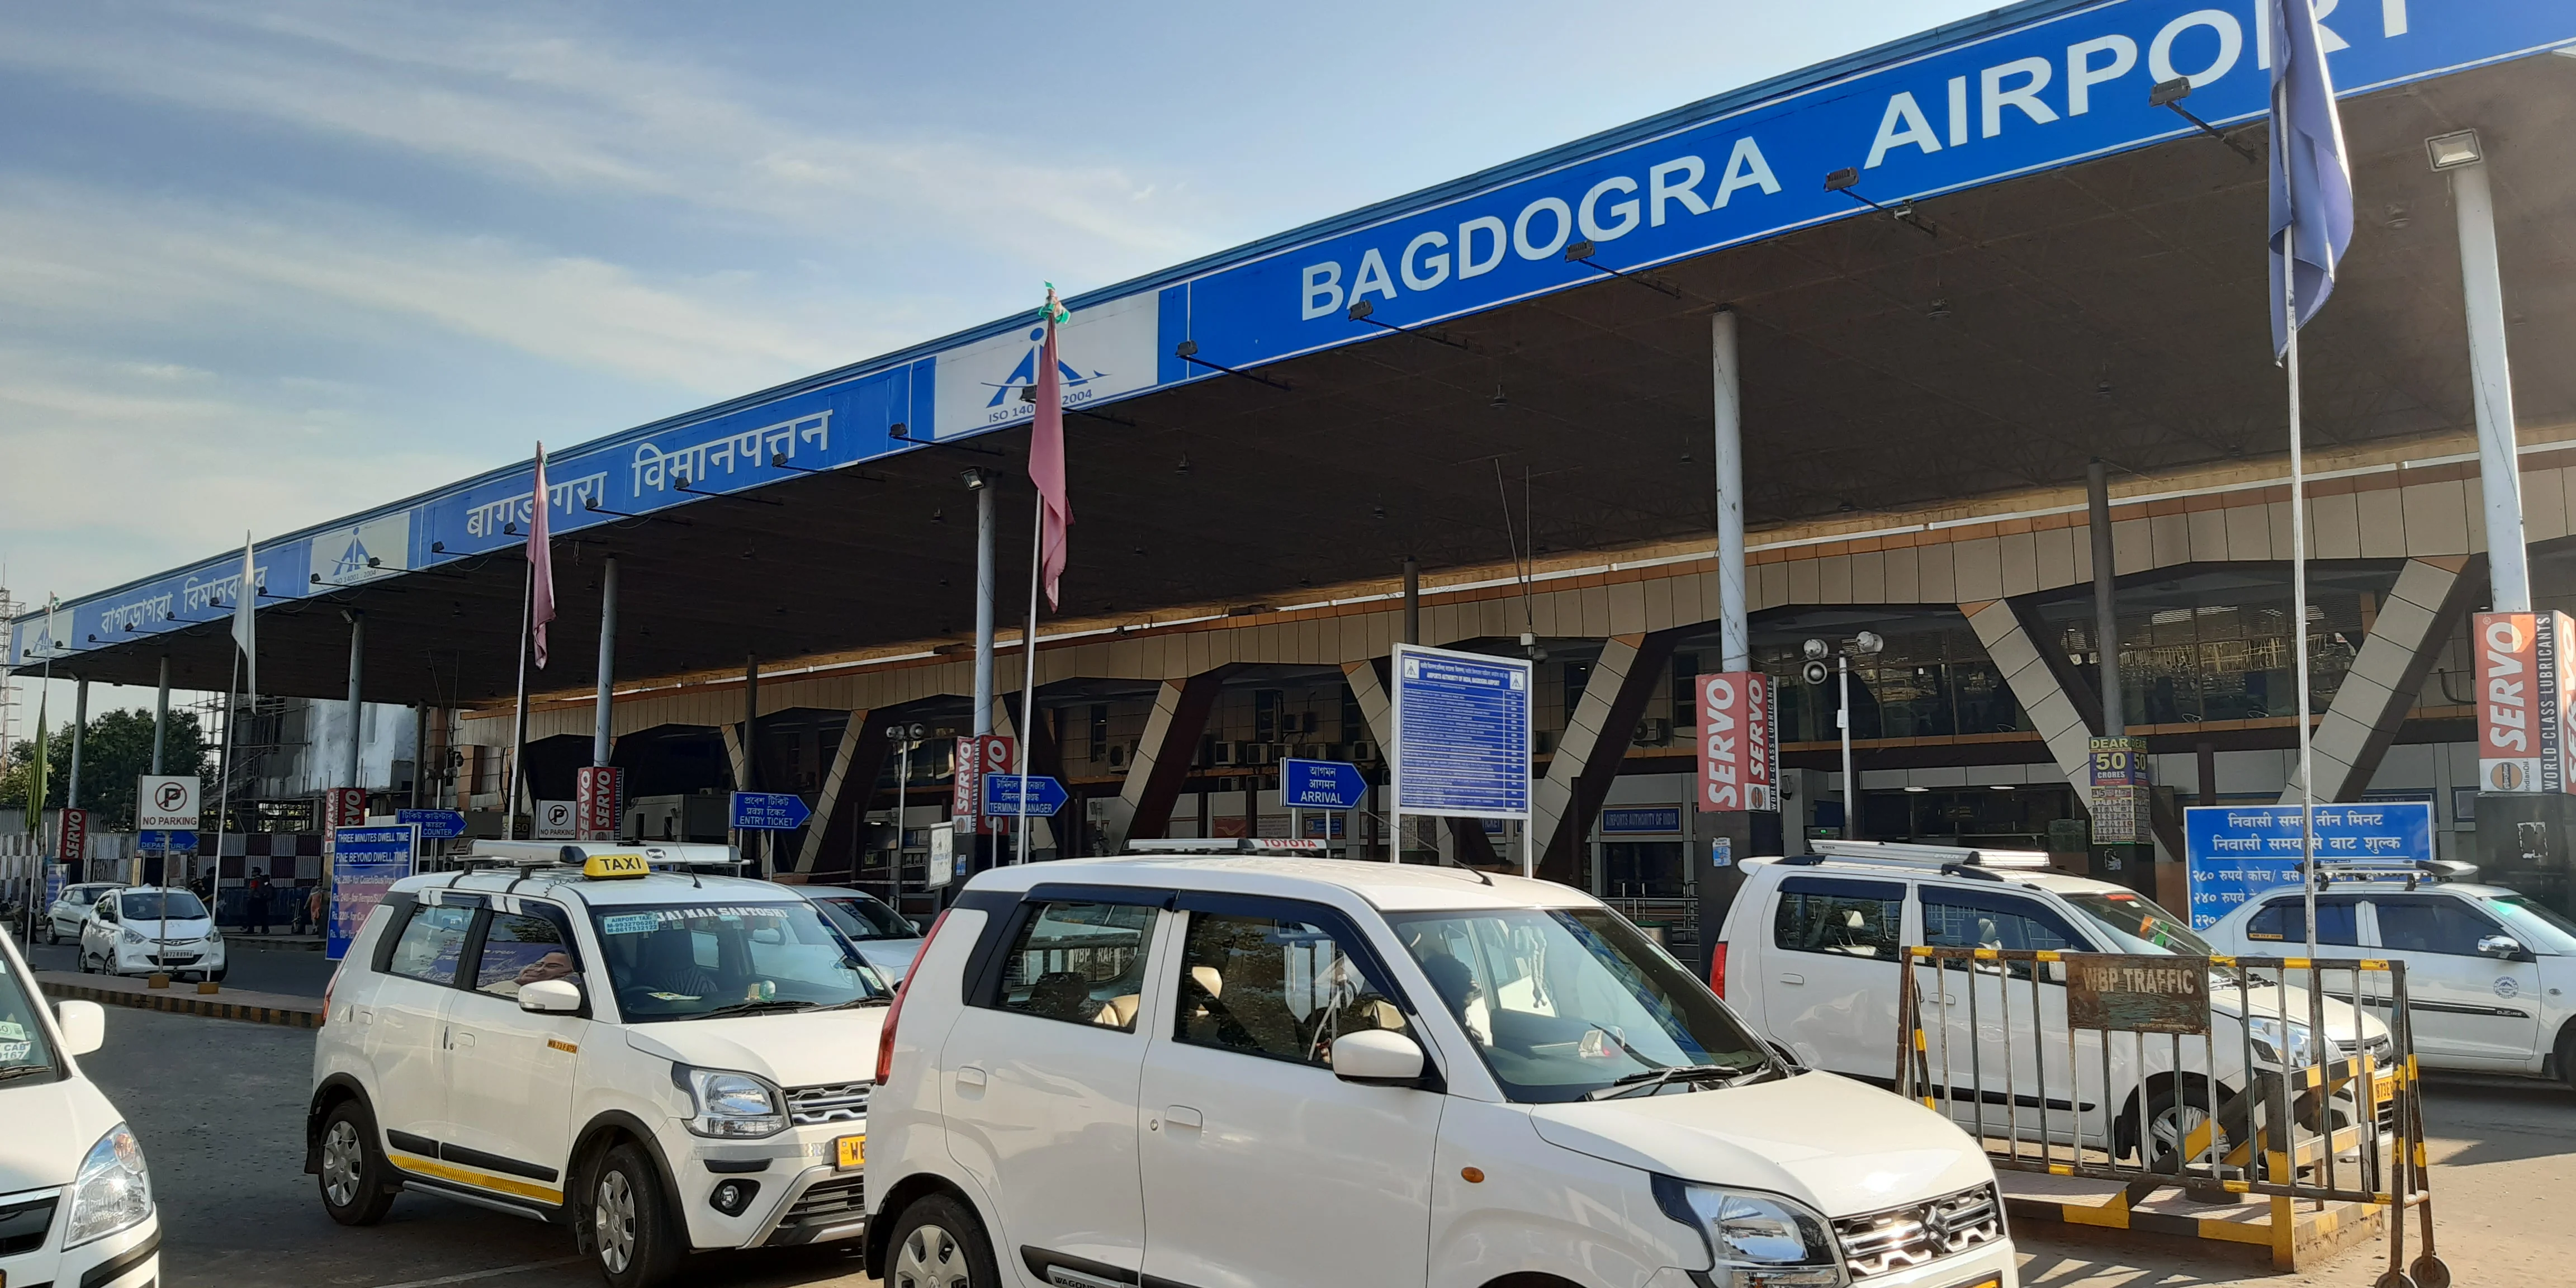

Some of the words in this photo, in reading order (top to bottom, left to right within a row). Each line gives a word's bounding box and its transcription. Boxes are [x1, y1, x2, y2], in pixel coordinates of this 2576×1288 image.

[1301, 136, 1782, 321] BAGDOGRA
[989, 410, 1008, 423] ISO
[1013, 404, 1035, 417] 140
[1063, 389, 1092, 405] 2004
[632, 409, 833, 497] विमानपत्तन
[2537, 617, 2554, 694] LUBRICANTS
[2486, 622, 2527, 752] SERVO
[1748, 679, 1765, 780] SERVO
[1706, 679, 1737, 808] SERVO
[2091, 738, 2128, 749] DEAR
[2541, 699, 2559, 790] WORLD-CLASS
[2096, 752, 2126, 770] 50
[2134, 754, 2146, 770] 50
[957, 742, 971, 812] SERVO
[1309, 766, 1336, 777] আগমন
[1309, 779, 1336, 790] आगमन
[580, 770, 591, 841] SERVO
[596, 770, 611, 828] SERVO
[1300, 790, 1343, 804] ARRIVAL
[326, 792, 335, 838] SERVO
[344, 790, 361, 826] RVO
[989, 803, 1020, 812] TERMINAL
[1025, 803, 1052, 813] ANAGER
[143, 817, 156, 825] NO
[158, 817, 197, 825] PARKING
[740, 816, 765, 825] ENTRY
[767, 817, 793, 826] TICKET
[2228, 812, 2272, 828] निवासी
[2315, 811, 2342, 826] तीन
[2348, 811, 2383, 826] मिनट
[65, 811, 83, 859] SERVO
[338, 834, 354, 842] THREE
[354, 833, 377, 842] MINUTES
[377, 832, 395, 842] DWELL
[396, 832, 409, 841] TIME
[1261, 839, 1317, 848] TOYOTA
[2212, 833, 2262, 851] निवासी
[2329, 836, 2357, 850] वाट
[2364, 836, 2402, 855] शुल्क
[336, 853, 348, 862] FINE
[349, 852, 372, 862] BEYOND
[373, 852, 393, 862] DWELL
[394, 851, 408, 861] TIME
[600, 857, 642, 872] TAXI
[2193, 870, 2214, 882] २८०
[2219, 866, 2242, 882] रुपये
[2282, 870, 2300, 882] बस
[2194, 892, 2217, 905] २४०
[2221, 889, 2246, 905] रुपये
[657, 910, 684, 922] JAI
[683, 908, 718, 918] MAA
[717, 907, 790, 918] SANTOSHI
[2083, 967, 2119, 992] WBP
[2123, 968, 2194, 994] TRAFFIC
